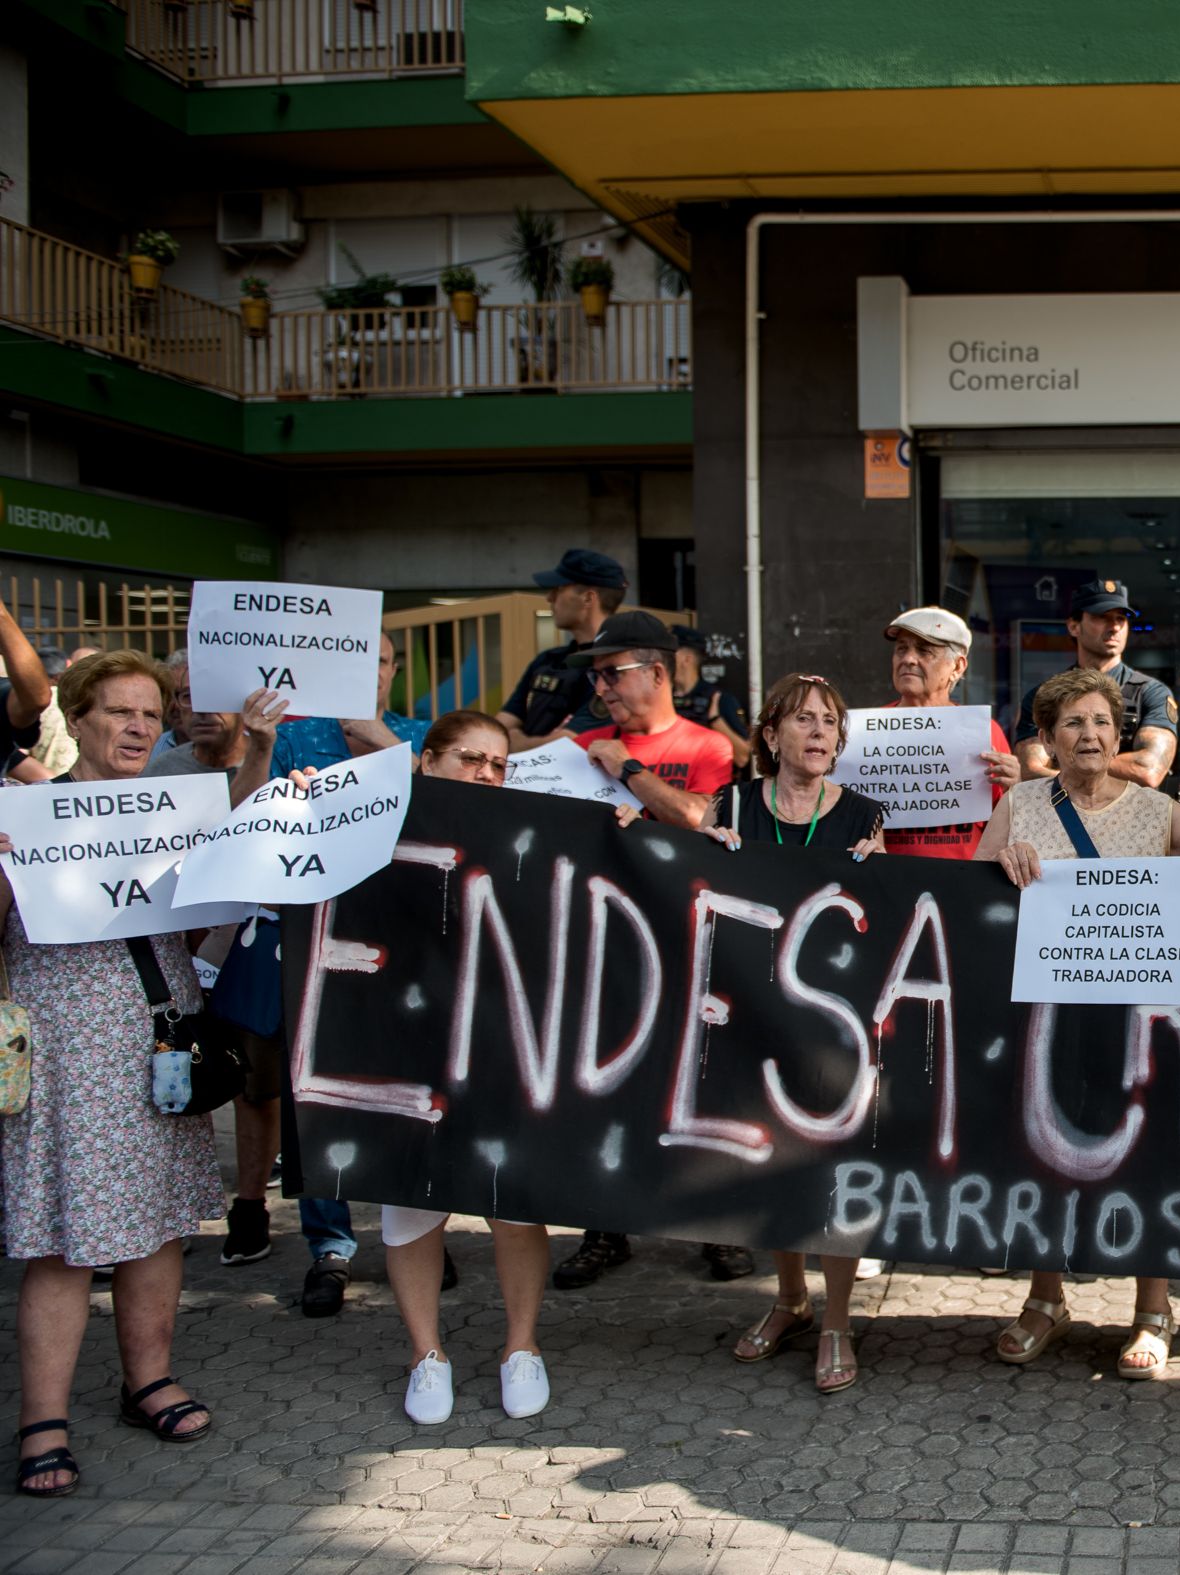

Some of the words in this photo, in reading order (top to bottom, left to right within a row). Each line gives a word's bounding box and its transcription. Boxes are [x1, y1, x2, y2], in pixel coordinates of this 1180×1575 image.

[948, 341, 1040, 363] Oficina
[948, 369, 1080, 391] Comercial
[7, 504, 111, 540] IBERDROLA
[233, 593, 332, 616] ENDESA
[199, 630, 368, 653] NACIONALIZACIÓN
[258, 666, 297, 690] YA
[866, 717, 942, 731] ENDESA:
[863, 746, 881, 757] LA
[886, 745, 945, 757] CODICIA
[859, 763, 950, 776] CAPITALISTA
[252, 770, 359, 804] ENDESA
[902, 783, 923, 793] LA
[925, 780, 973, 793] CLASE
[53, 790, 177, 820] ENDESA
[881, 798, 960, 812] BAJADORA
[202, 795, 399, 845] NACIONALIZACIÓN
[11, 829, 208, 866] NACIONALIZACIÓ
[278, 853, 326, 877] YA
[1076, 869, 1159, 885] ENDESA:
[100, 878, 152, 909] YA
[1072, 904, 1091, 917] LA
[1096, 903, 1161, 917] CODICIA
[1065, 925, 1165, 938] CAPITALISTA
[1039, 947, 1105, 960] CONTRA
[1110, 947, 1130, 960] LA
[1052, 969, 1173, 983] TRABAJADORA
[293, 842, 957, 1164] ENDESA
